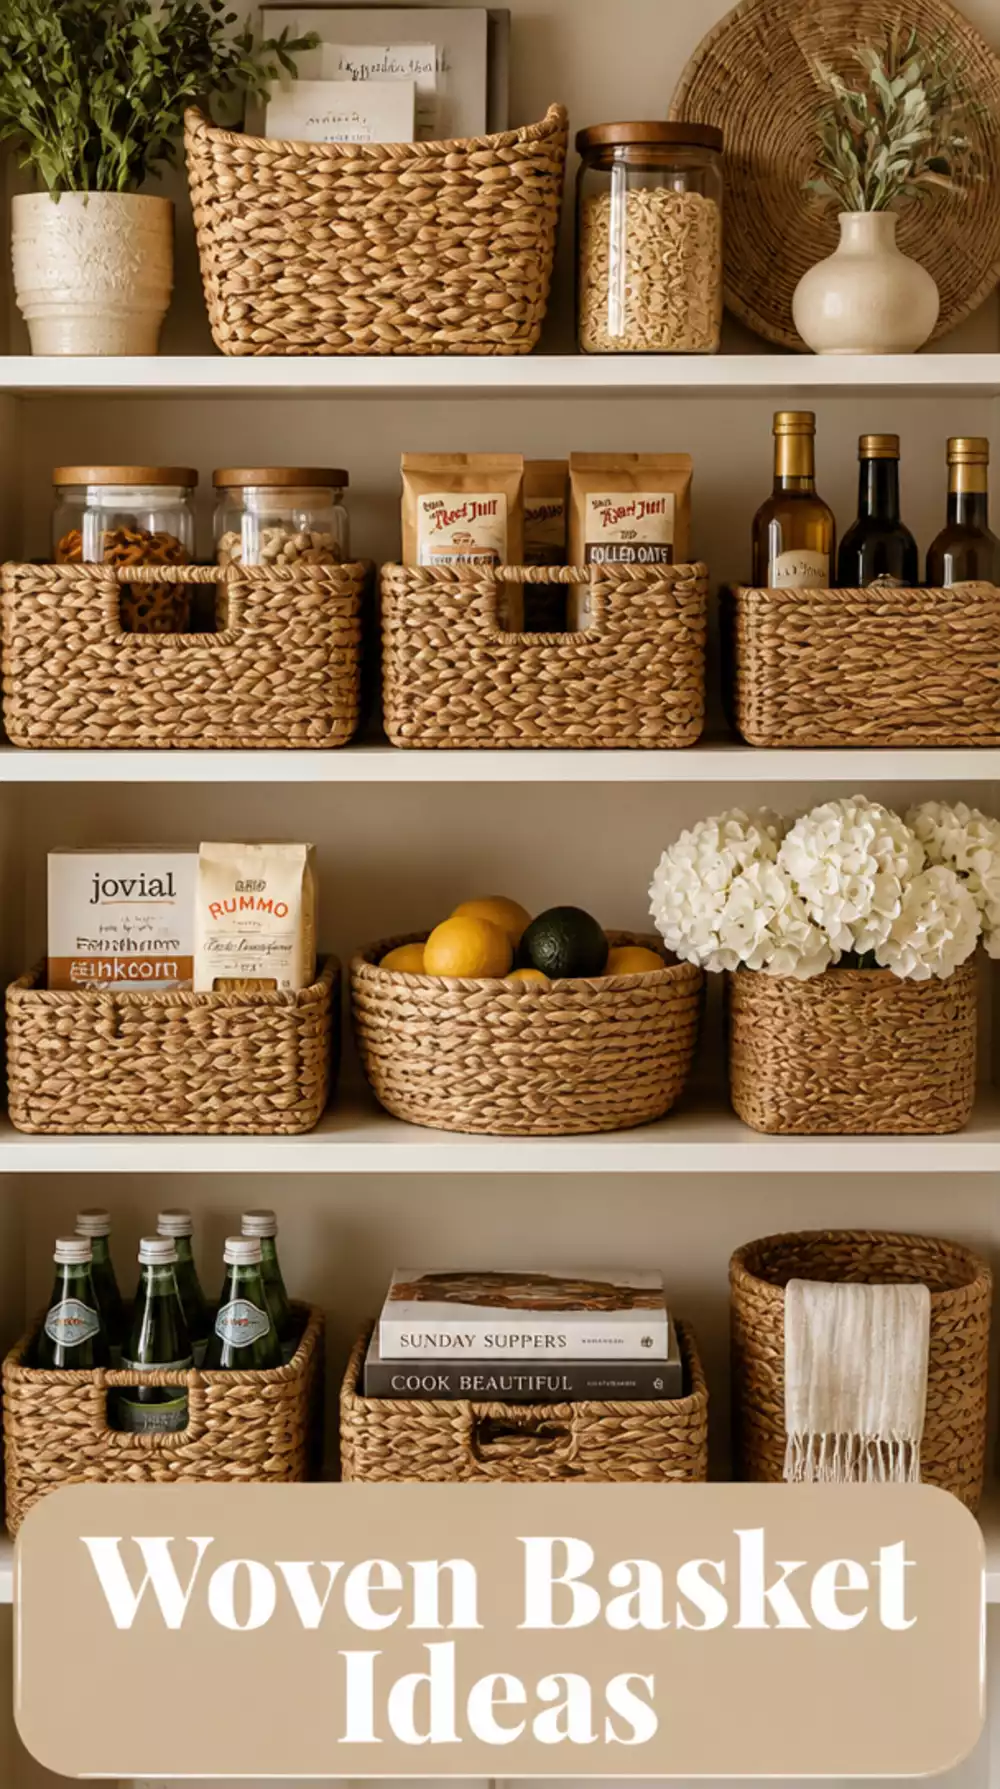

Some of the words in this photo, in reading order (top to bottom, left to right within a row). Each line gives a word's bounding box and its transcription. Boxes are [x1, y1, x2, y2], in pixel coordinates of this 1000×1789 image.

[89, 872, 177, 905] jovial
[208, 896, 289, 920] RUMMO
[400, 1334, 476, 1349] SUNDAY
[484, 1334, 567, 1349] SUPPERS
[391, 1375, 451, 1391] COOK
[460, 1375, 572, 1391] BEAUTIFUL
